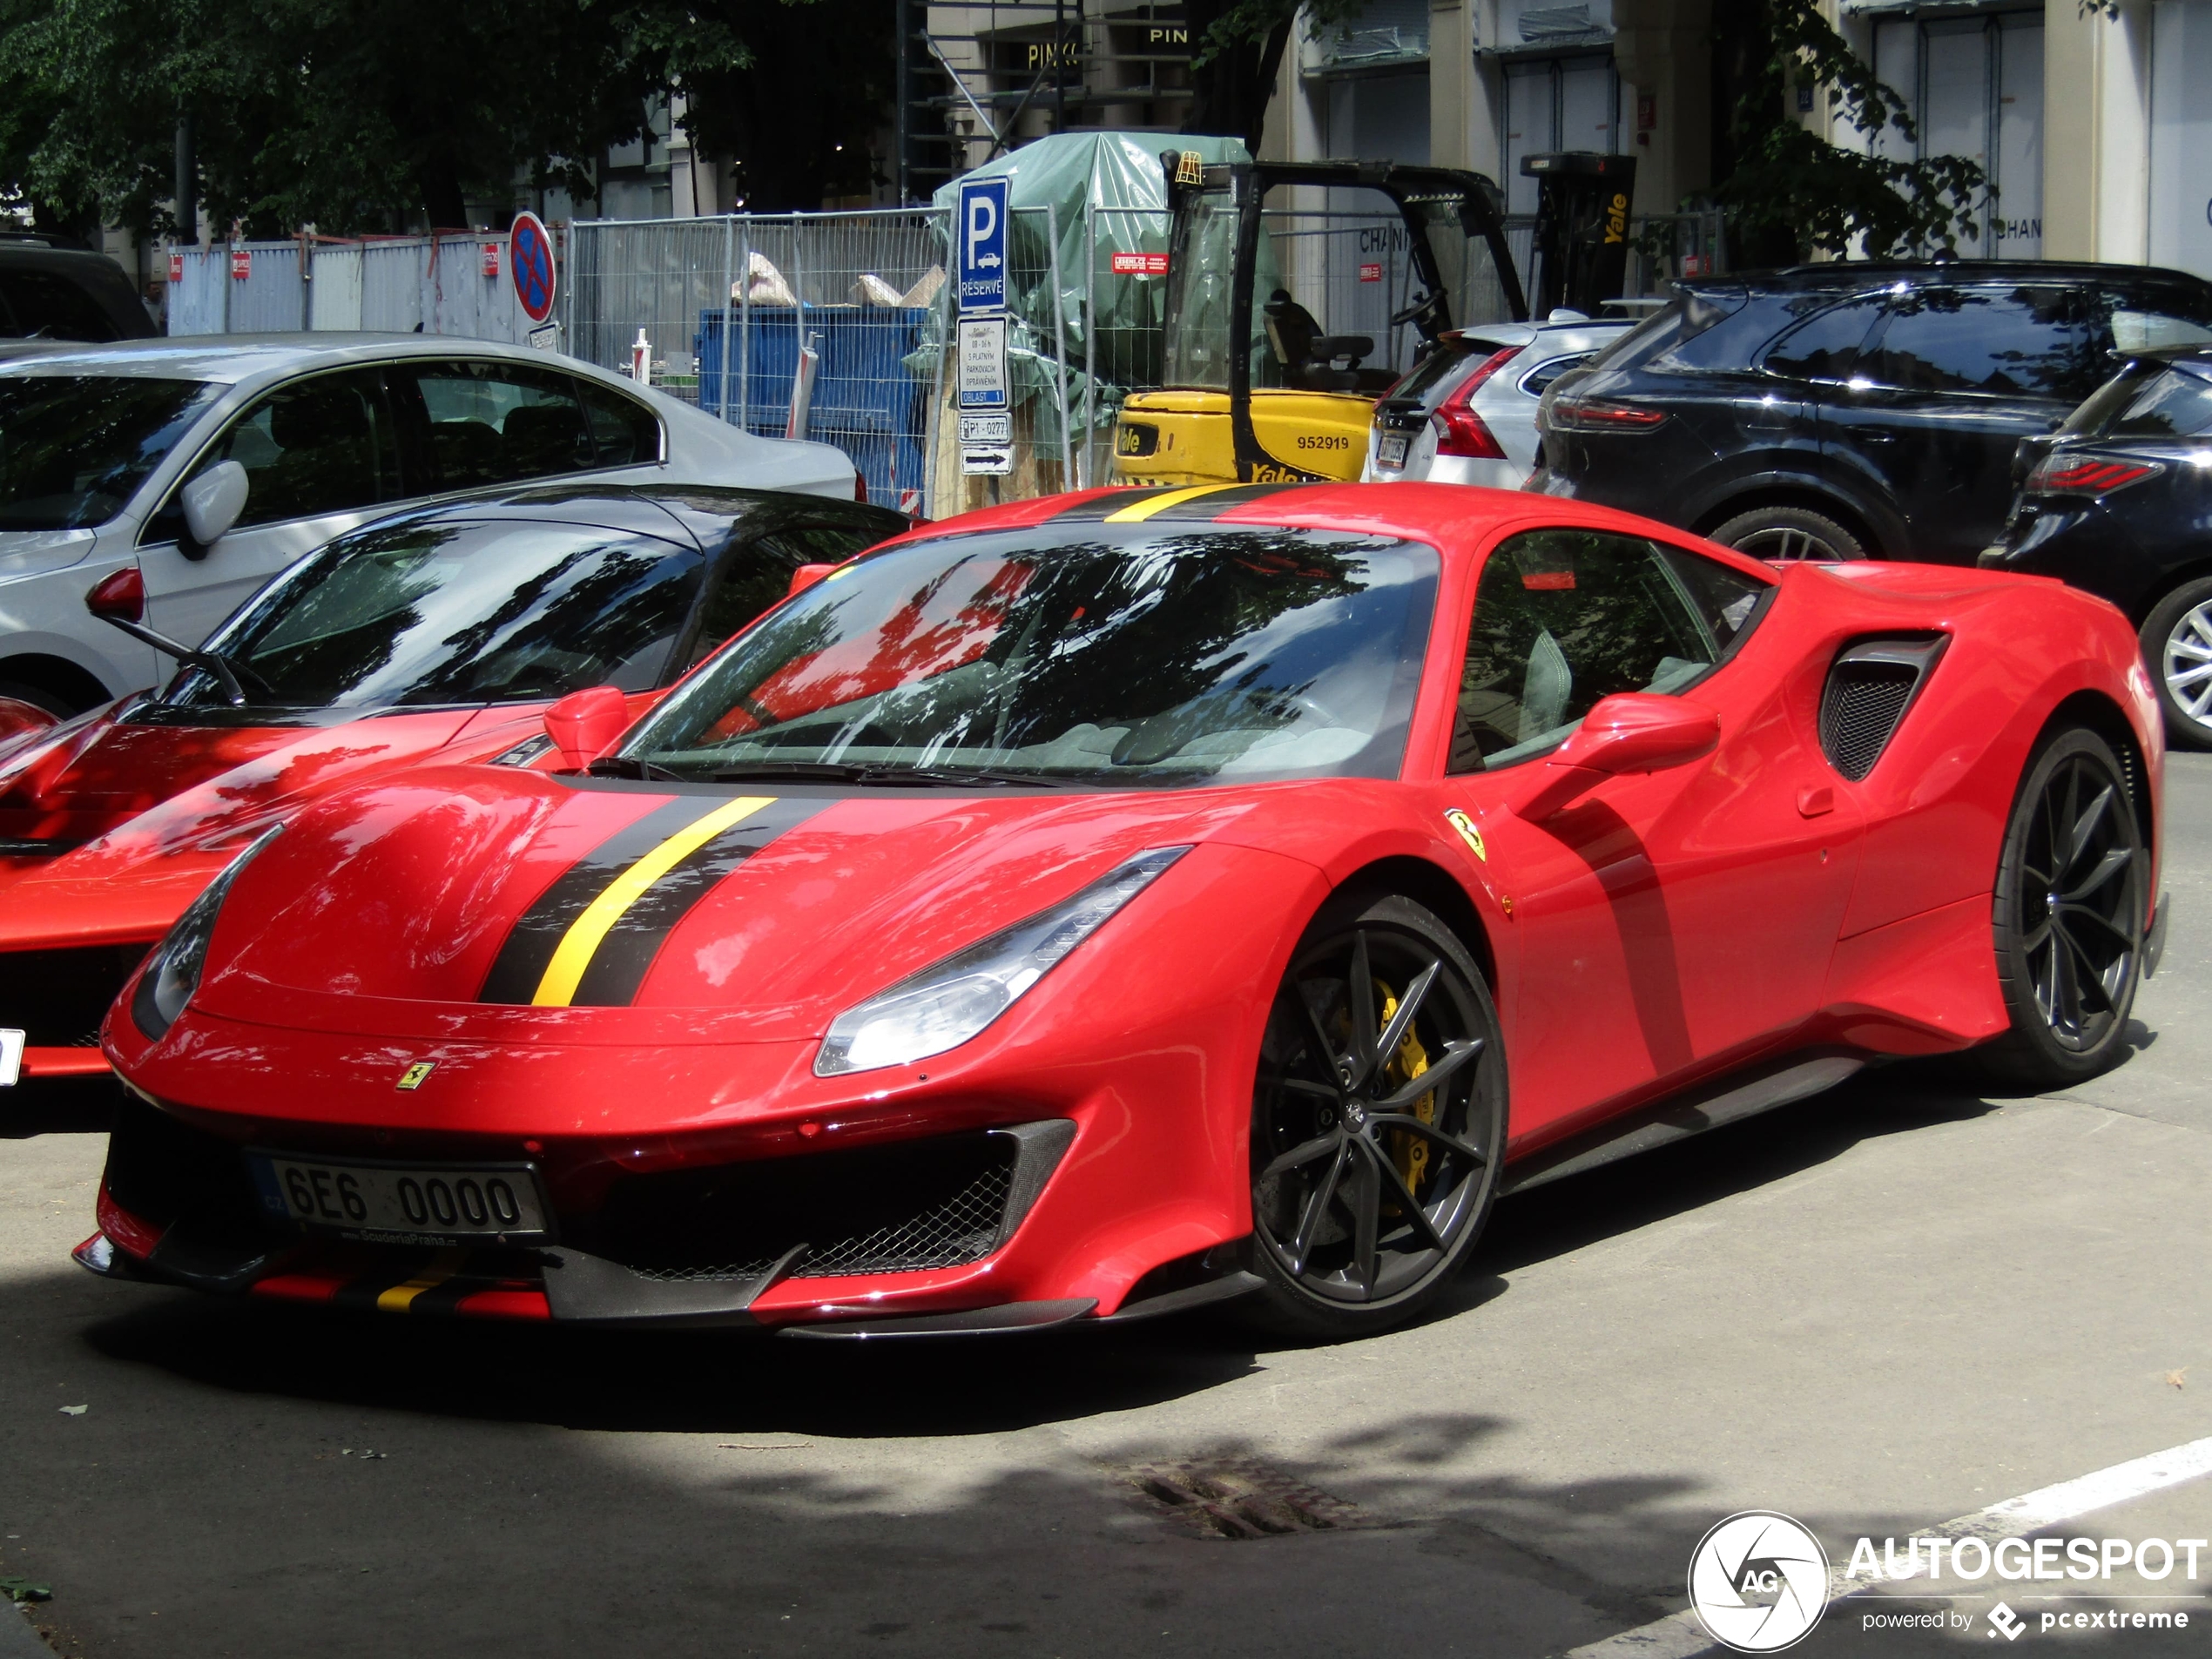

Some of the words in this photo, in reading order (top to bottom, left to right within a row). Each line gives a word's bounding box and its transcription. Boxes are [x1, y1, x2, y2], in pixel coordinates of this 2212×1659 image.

[1150, 29, 1187, 44] PIN
[1604, 193, 1627, 244] Yale
[968, 196, 996, 270] P
[972, 350, 995, 361] PLATNÝM
[966, 362, 996, 374] PARKOVACÍM
[966, 375, 997, 386] OPRÁVNĚNÍM
[963, 392, 988, 402] OBLAST
[996, 391, 1000, 401] 1
[987, 422, 1005, 435] 0277
[1297, 436, 1349, 449] 952919
[264, 1195, 285, 1210] CZ
[285, 1166, 368, 1222] 6E6
[397, 1177, 521, 1227] 0000
